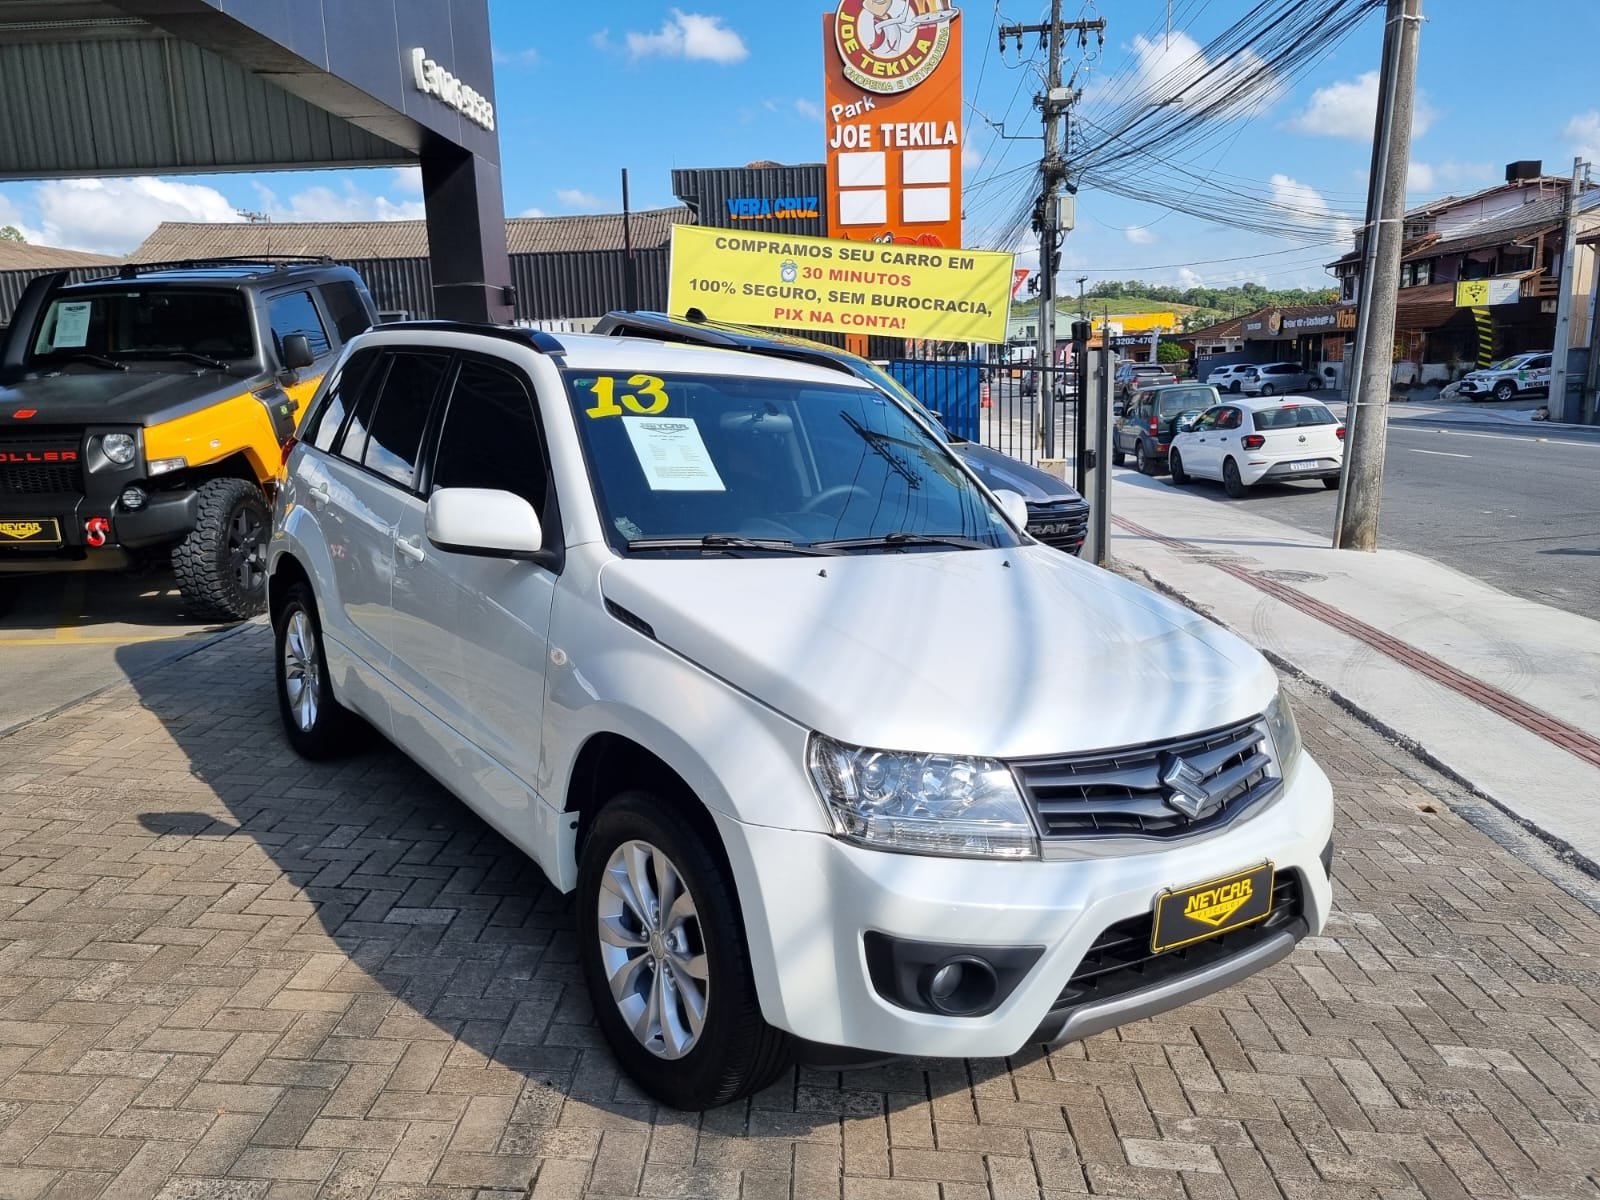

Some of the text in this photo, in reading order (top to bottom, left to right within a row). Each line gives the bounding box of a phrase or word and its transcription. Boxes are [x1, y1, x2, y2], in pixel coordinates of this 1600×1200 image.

[840, 11, 931, 76] JOE TEKILA
[831, 95, 876, 122] Park
[830, 121, 958, 149] JOE TEKILA
[726, 196, 818, 220] VERA CRUZ
[715, 236, 975, 270] COMPRAMOS SEU CARRO EM
[802, 266, 912, 287] 30 MINUTOS
[689, 278, 992, 318] 100% SEGURO, SEM BUROCRACIA,
[774, 307, 906, 330] PIX NA CONTA!
[585, 374, 669, 419] 13
[1184, 878, 1253, 913] NEYCAR
